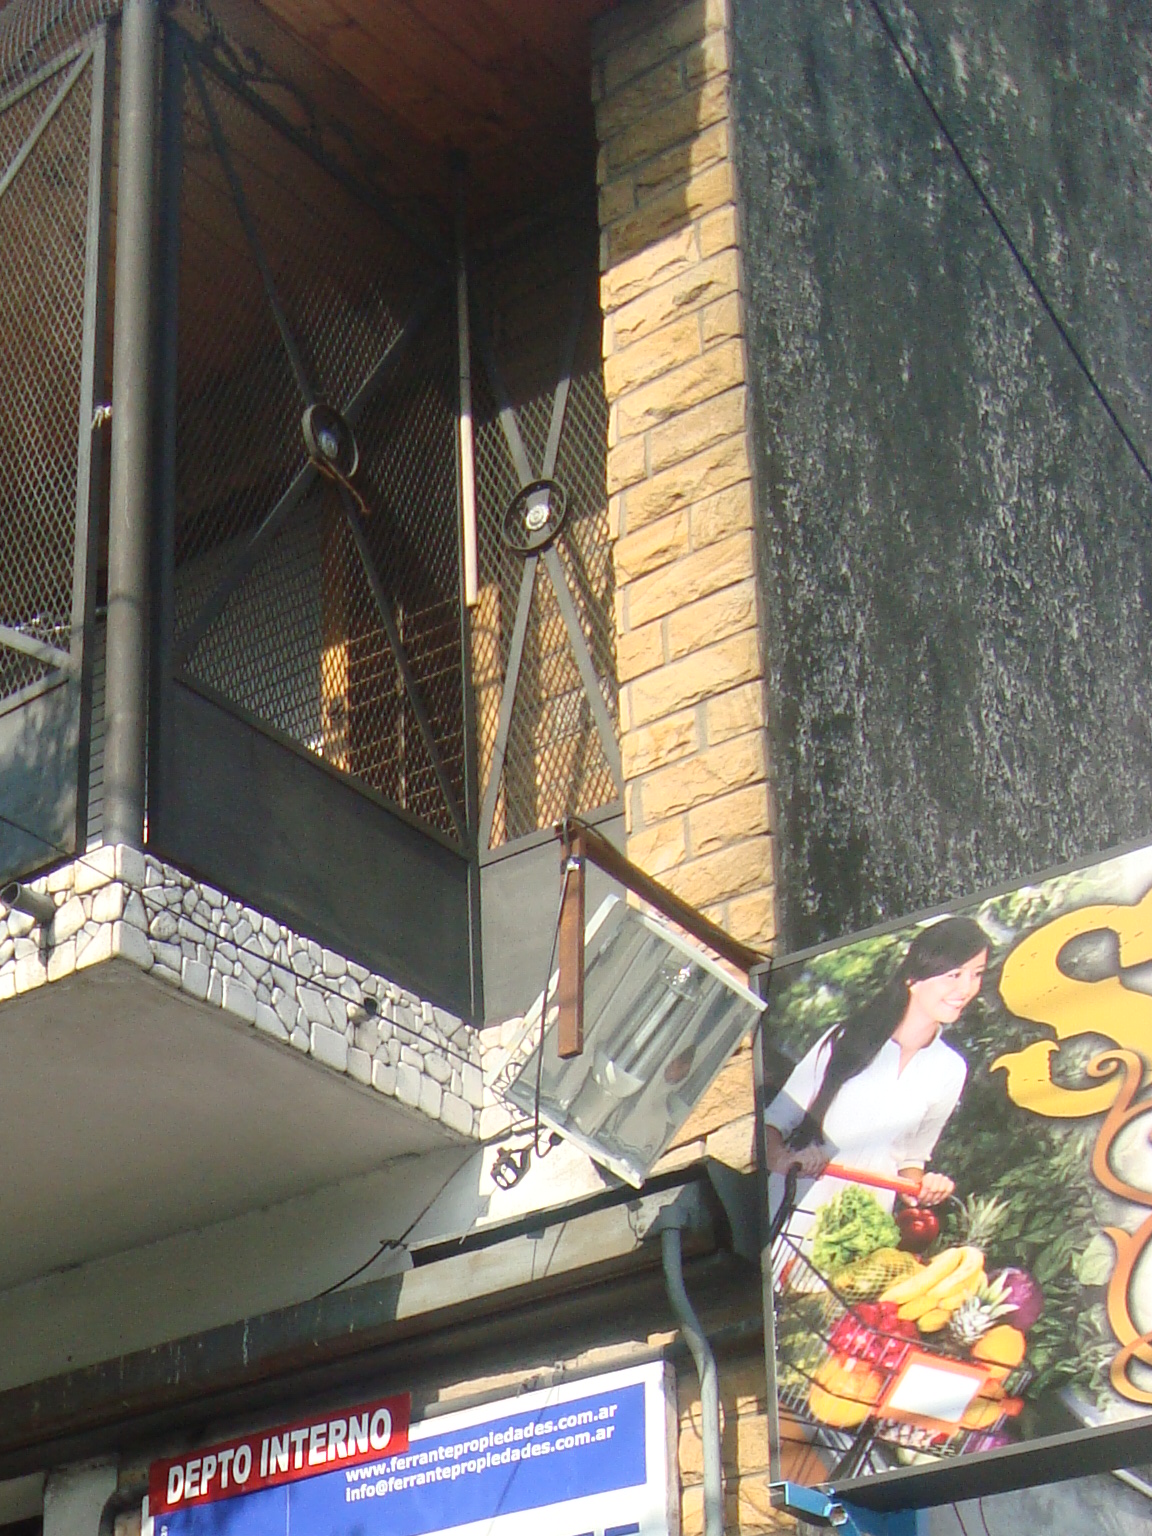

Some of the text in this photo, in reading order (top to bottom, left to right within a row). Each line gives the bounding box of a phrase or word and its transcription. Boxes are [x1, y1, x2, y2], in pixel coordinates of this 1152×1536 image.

[167, 1407, 393, 1505] DEPTO INTERNO
[345, 1402, 618, 1482] www.ferrantepropiedades.com.ar
[346, 1425, 615, 1502] info@ferrantepropiedades.com.ar
